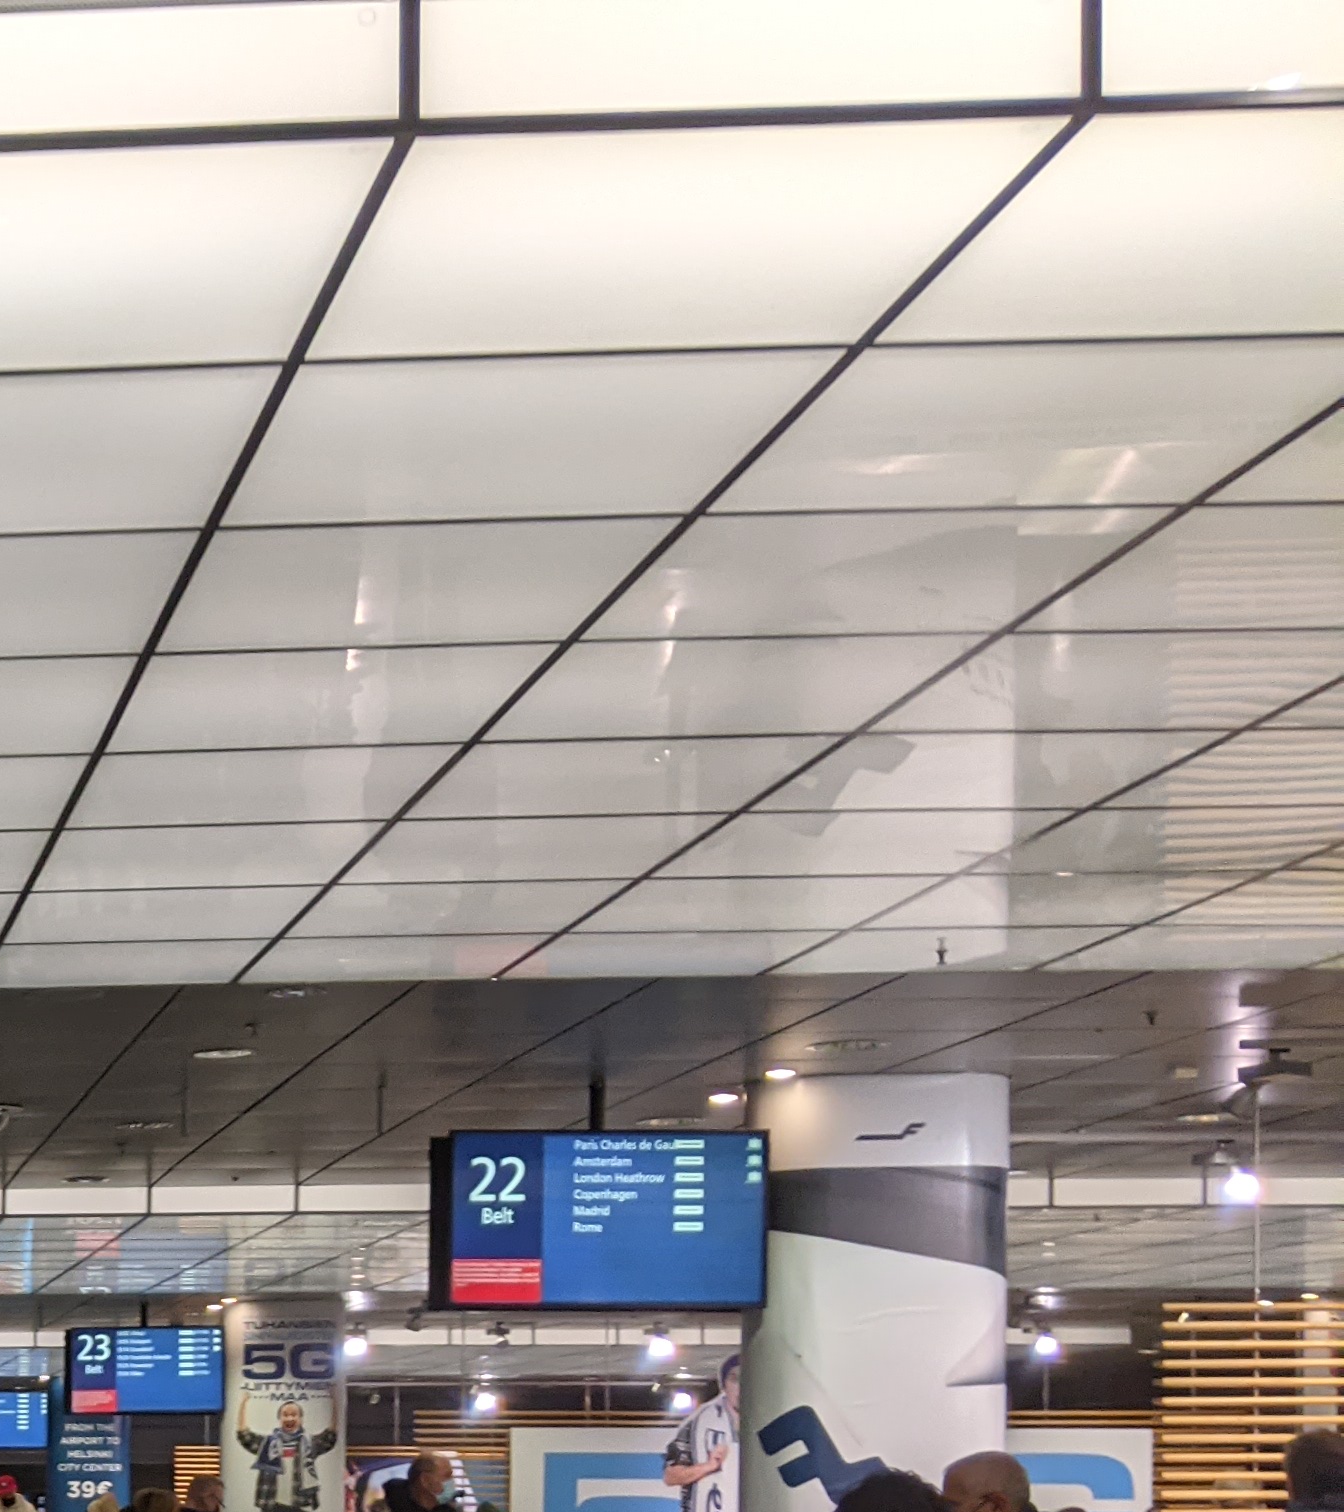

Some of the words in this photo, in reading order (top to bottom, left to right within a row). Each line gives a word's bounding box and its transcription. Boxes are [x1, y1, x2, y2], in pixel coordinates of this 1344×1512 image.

[574, 1139, 598, 1150] Paris
[600, 1139, 637, 1150] Charles
[638, 1139, 652, 1150] de
[654, 1139, 676, 1150] Gau
[573, 1156, 632, 1167] Amsterdam
[468, 1156, 527, 1203] 22
[573, 1172, 612, 1184] London
[614, 1172, 665, 1184] Heathrow
[573, 1188, 638, 1202] Copenhagen
[481, 1207, 514, 1225] Belt
[572, 1205, 611, 1217] Madrid
[572, 1221, 603, 1233] Rome
[77, 1334, 111, 1361] 23
[242, 1342, 335, 1380] 5G
[271, 1393, 309, 1401] MAA
[64, 1423, 94, 1432] FROM
[60, 1436, 104, 1445] AIRPORT
[106, 1436, 121, 1445] TO
[66, 1450, 113, 1458] HELSINKI
[57, 1463, 81, 1472] CITY
[82, 1463, 123, 1472] CENTER
[66, 1480, 113, 1499] 39€
